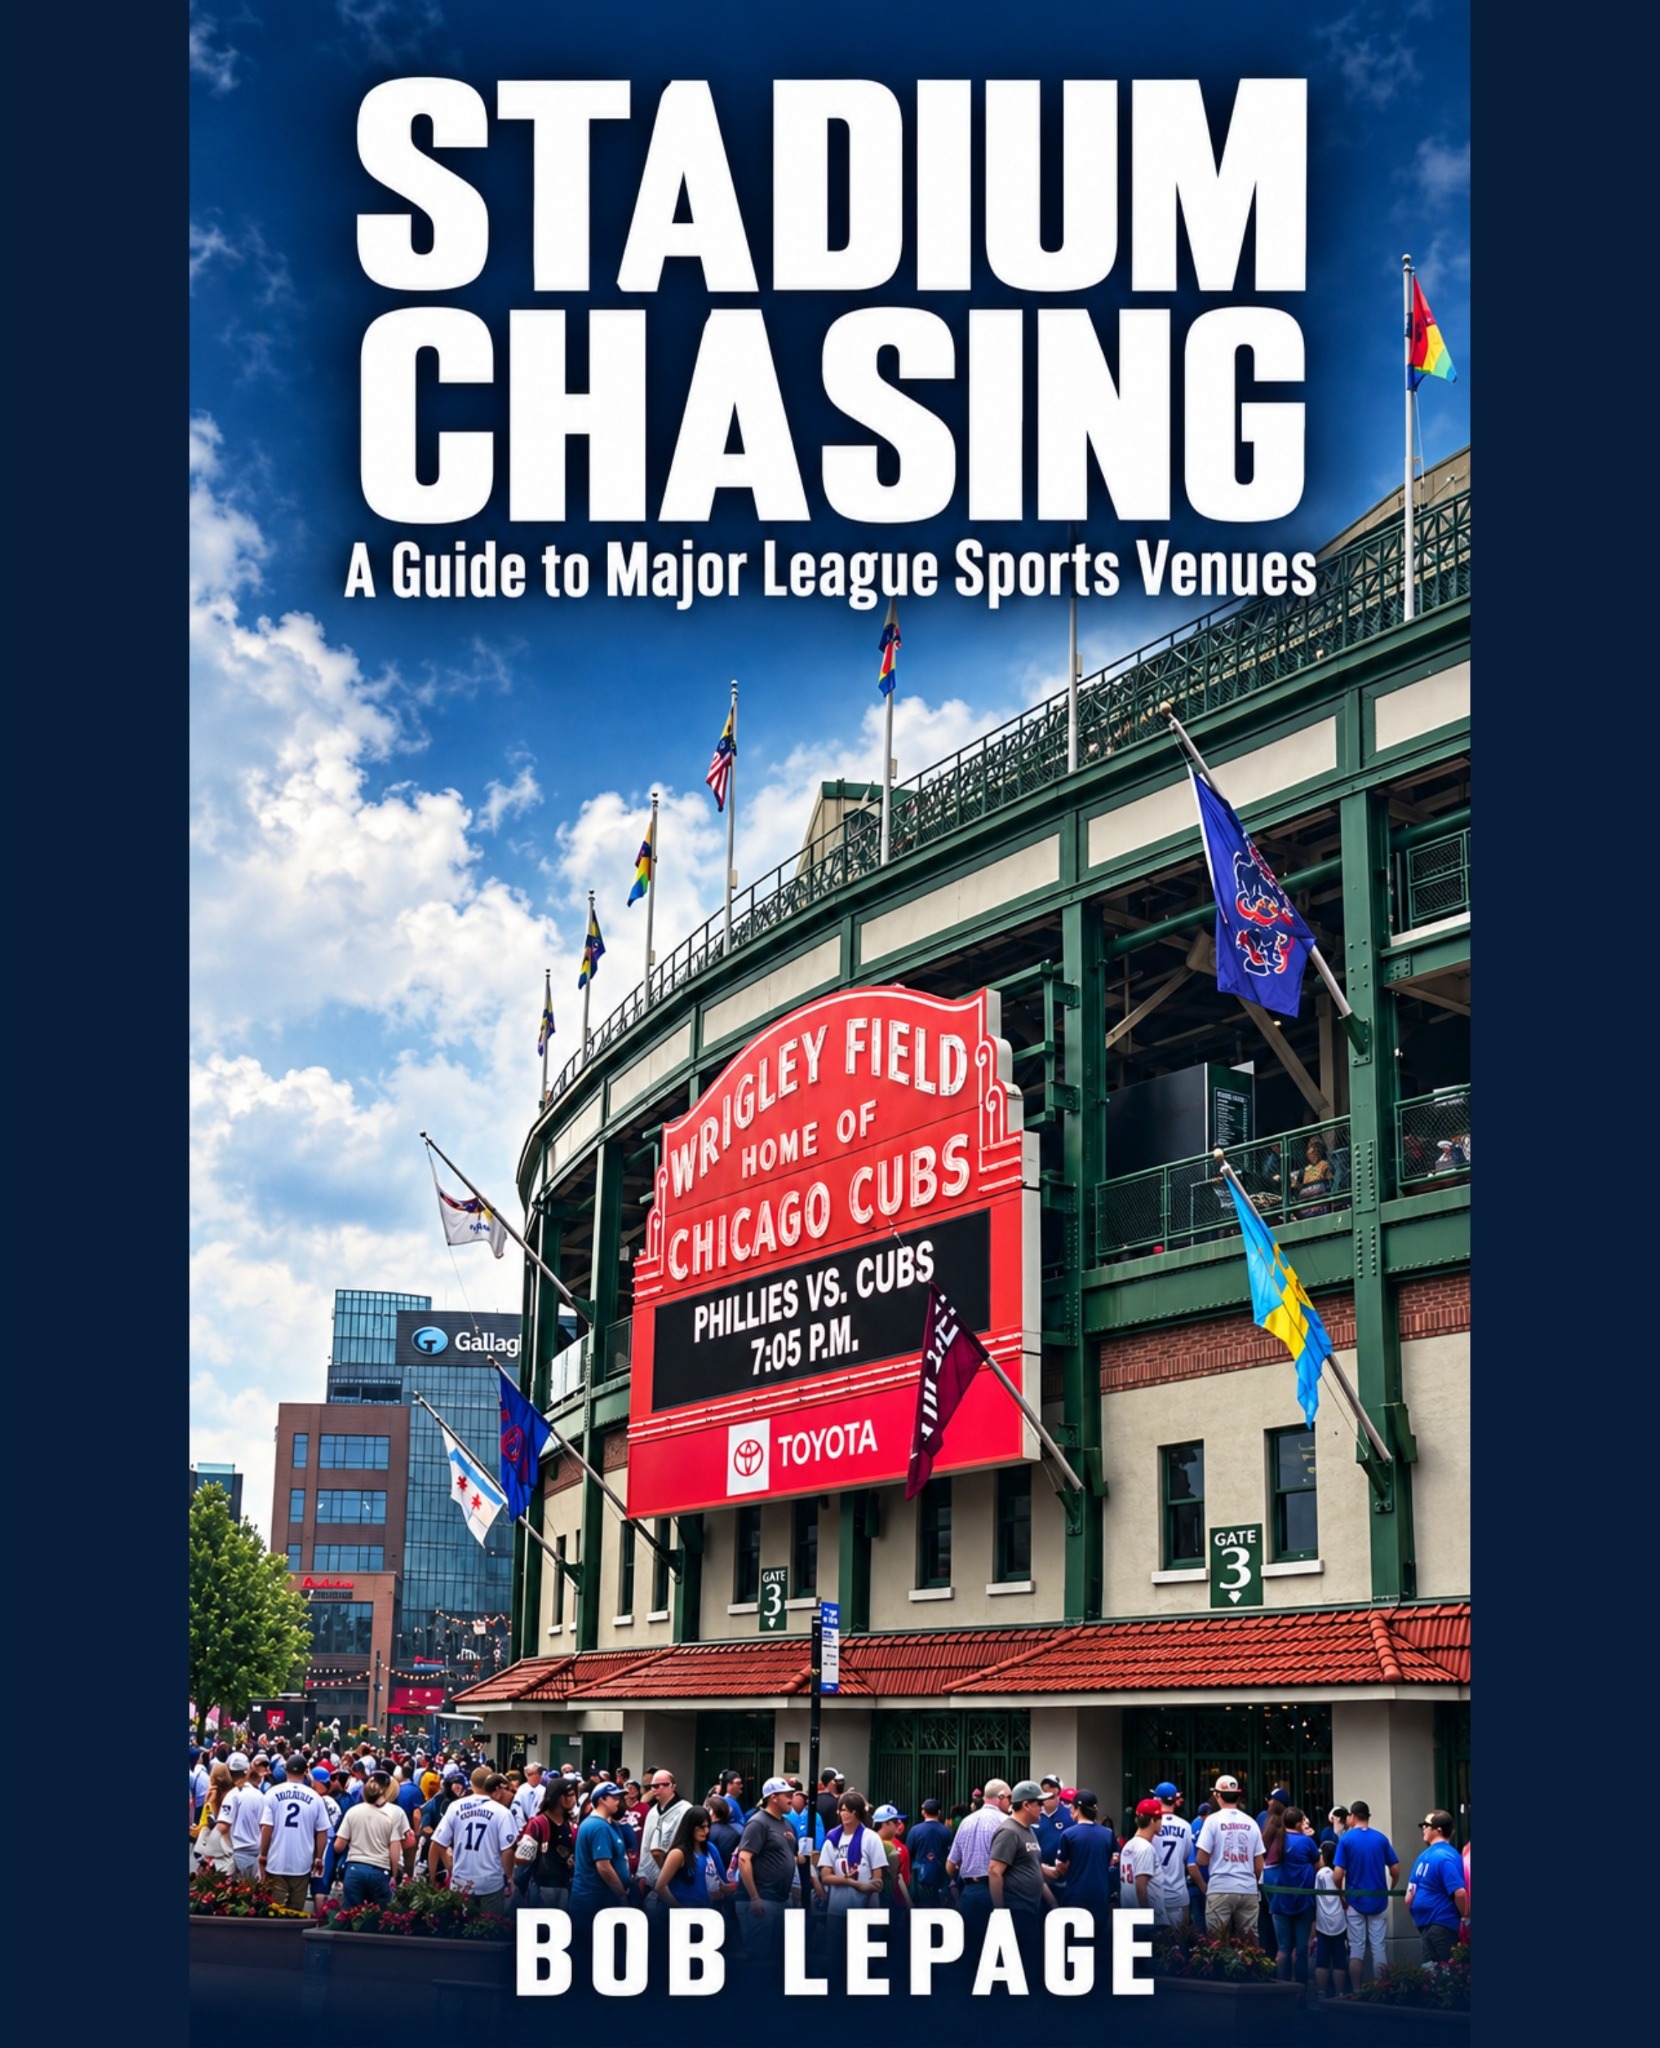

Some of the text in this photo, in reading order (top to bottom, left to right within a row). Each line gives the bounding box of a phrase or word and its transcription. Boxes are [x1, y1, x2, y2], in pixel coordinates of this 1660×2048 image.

[670, 1018, 968, 1198] WRIGLEY FIELD
[741, 1100, 877, 1179] HOME OF
[667, 1133, 971, 1281] CHICAGO CUBS
[693, 1240, 934, 1343] PHILLIES VS. CUBS
[454, 1331, 522, 1358] Gallag
[750, 1315, 859, 1376] 7:05 P.M.
[777, 1419, 878, 1467] TOYOTA
[1214, 1529, 1257, 1547] GATE
[762, 1570, 786, 1582] GATE
[1219, 1546, 1252, 1590] 3
[763, 1583, 782, 1617] 3
[284, 1802, 301, 1828] 2
[465, 1821, 488, 1852] 17
[1162, 1840, 1177, 1867] 7
